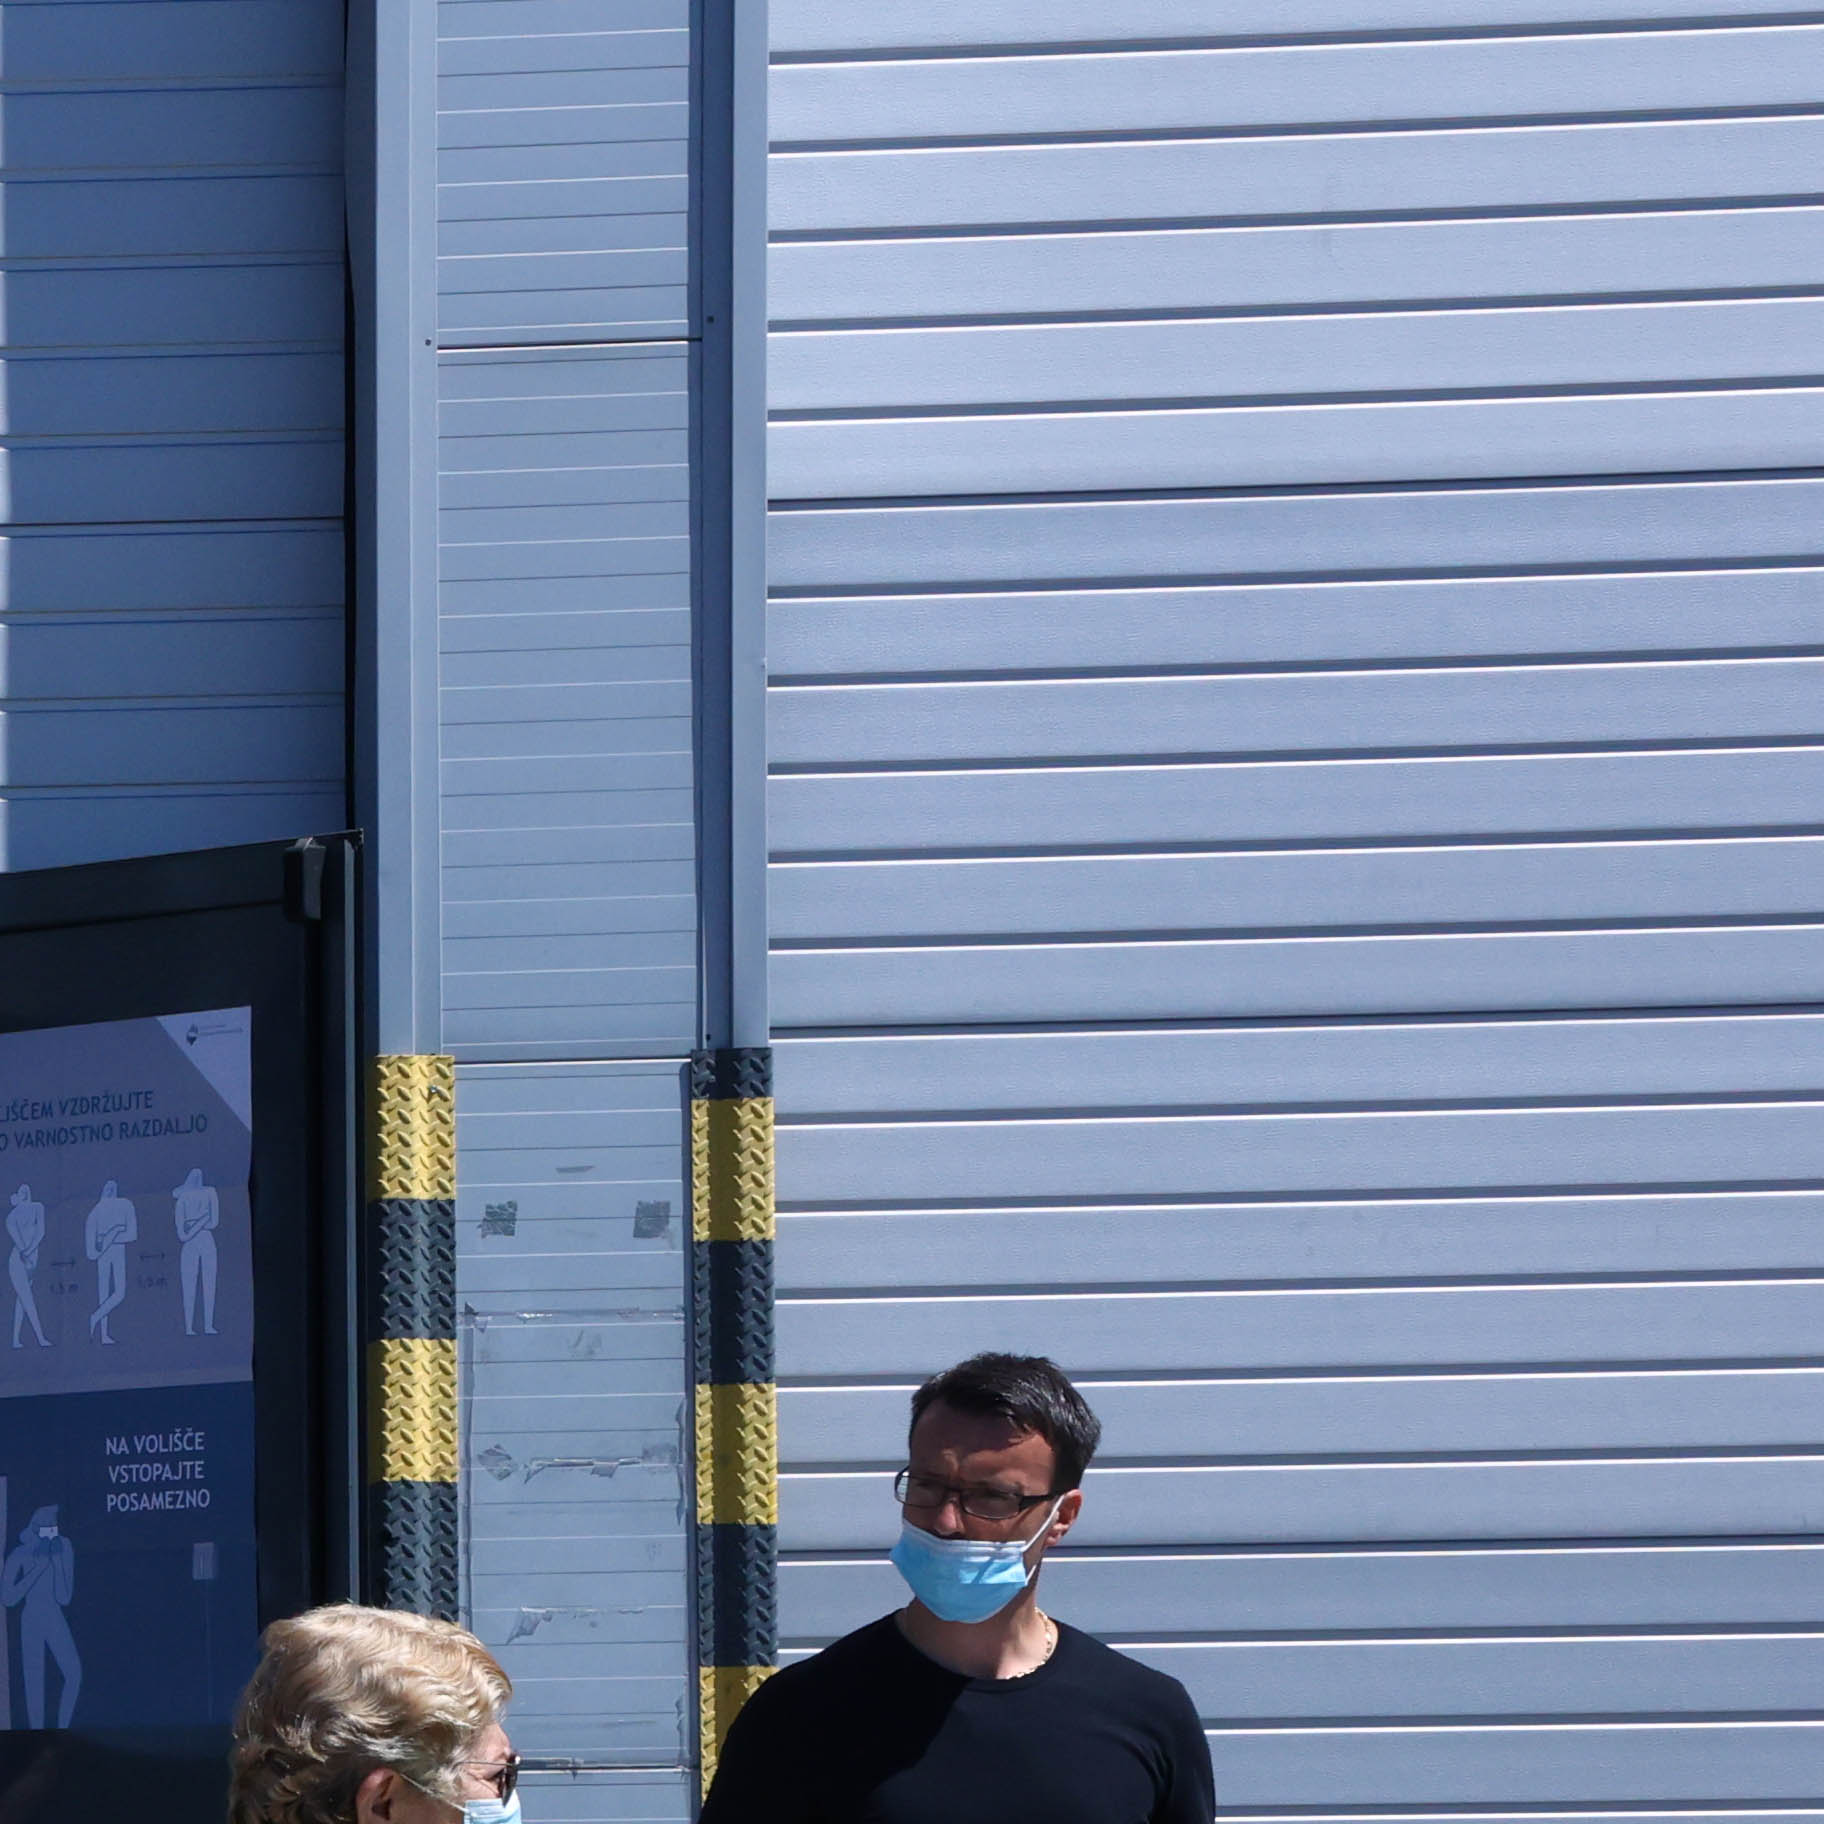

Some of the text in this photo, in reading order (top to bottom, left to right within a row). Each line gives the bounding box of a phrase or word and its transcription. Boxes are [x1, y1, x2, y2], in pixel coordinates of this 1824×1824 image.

[58, 1090, 153, 1116] VZDRŽUJTE
[14, 1123, 114, 1149] VARNOSTNO
[119, 1113, 207, 1140] RAZDALJO
[106, 1427, 205, 1456] NA VOLIŠČE
[109, 1461, 204, 1484] VSTOPAJTE
[107, 1489, 210, 1513] POSAMEZNO
